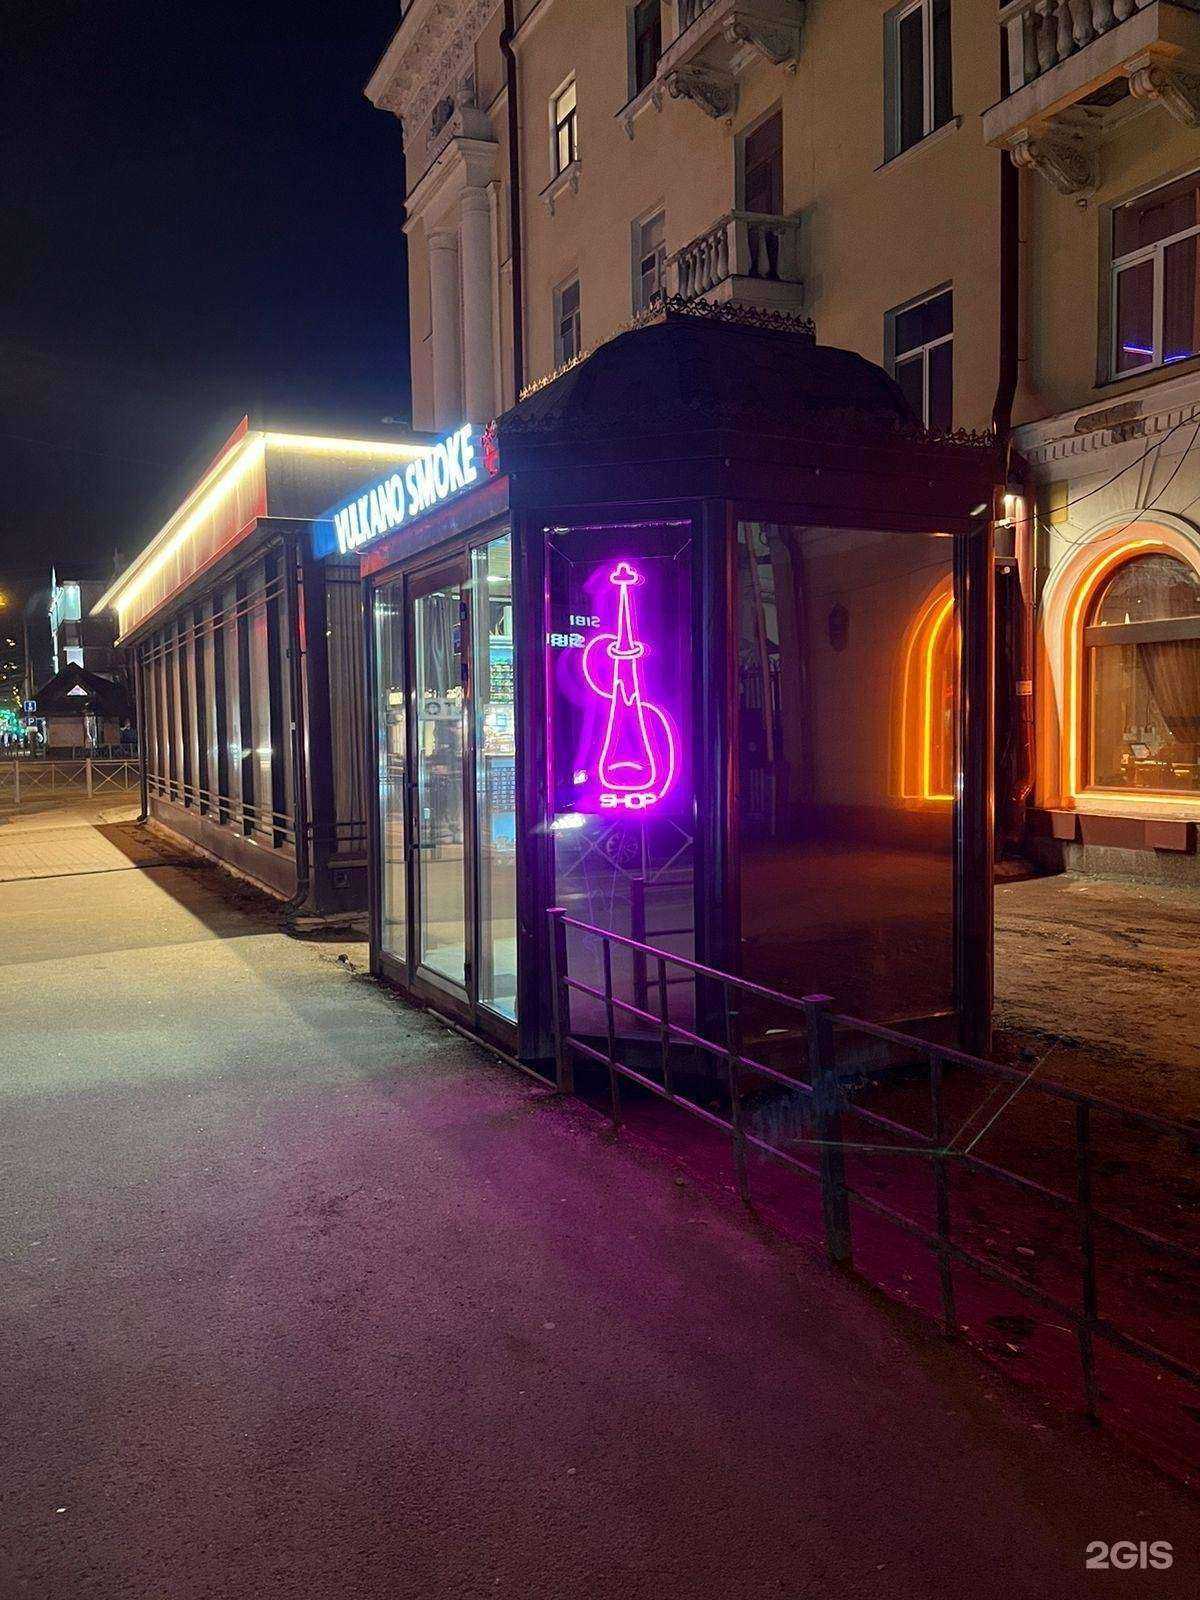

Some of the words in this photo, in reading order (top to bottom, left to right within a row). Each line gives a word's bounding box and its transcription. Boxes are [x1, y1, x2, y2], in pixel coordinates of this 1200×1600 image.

[334, 474, 405, 555] VULKANO
[405, 423, 477, 516] SMOKE
[600, 793, 658, 809] SHOP
